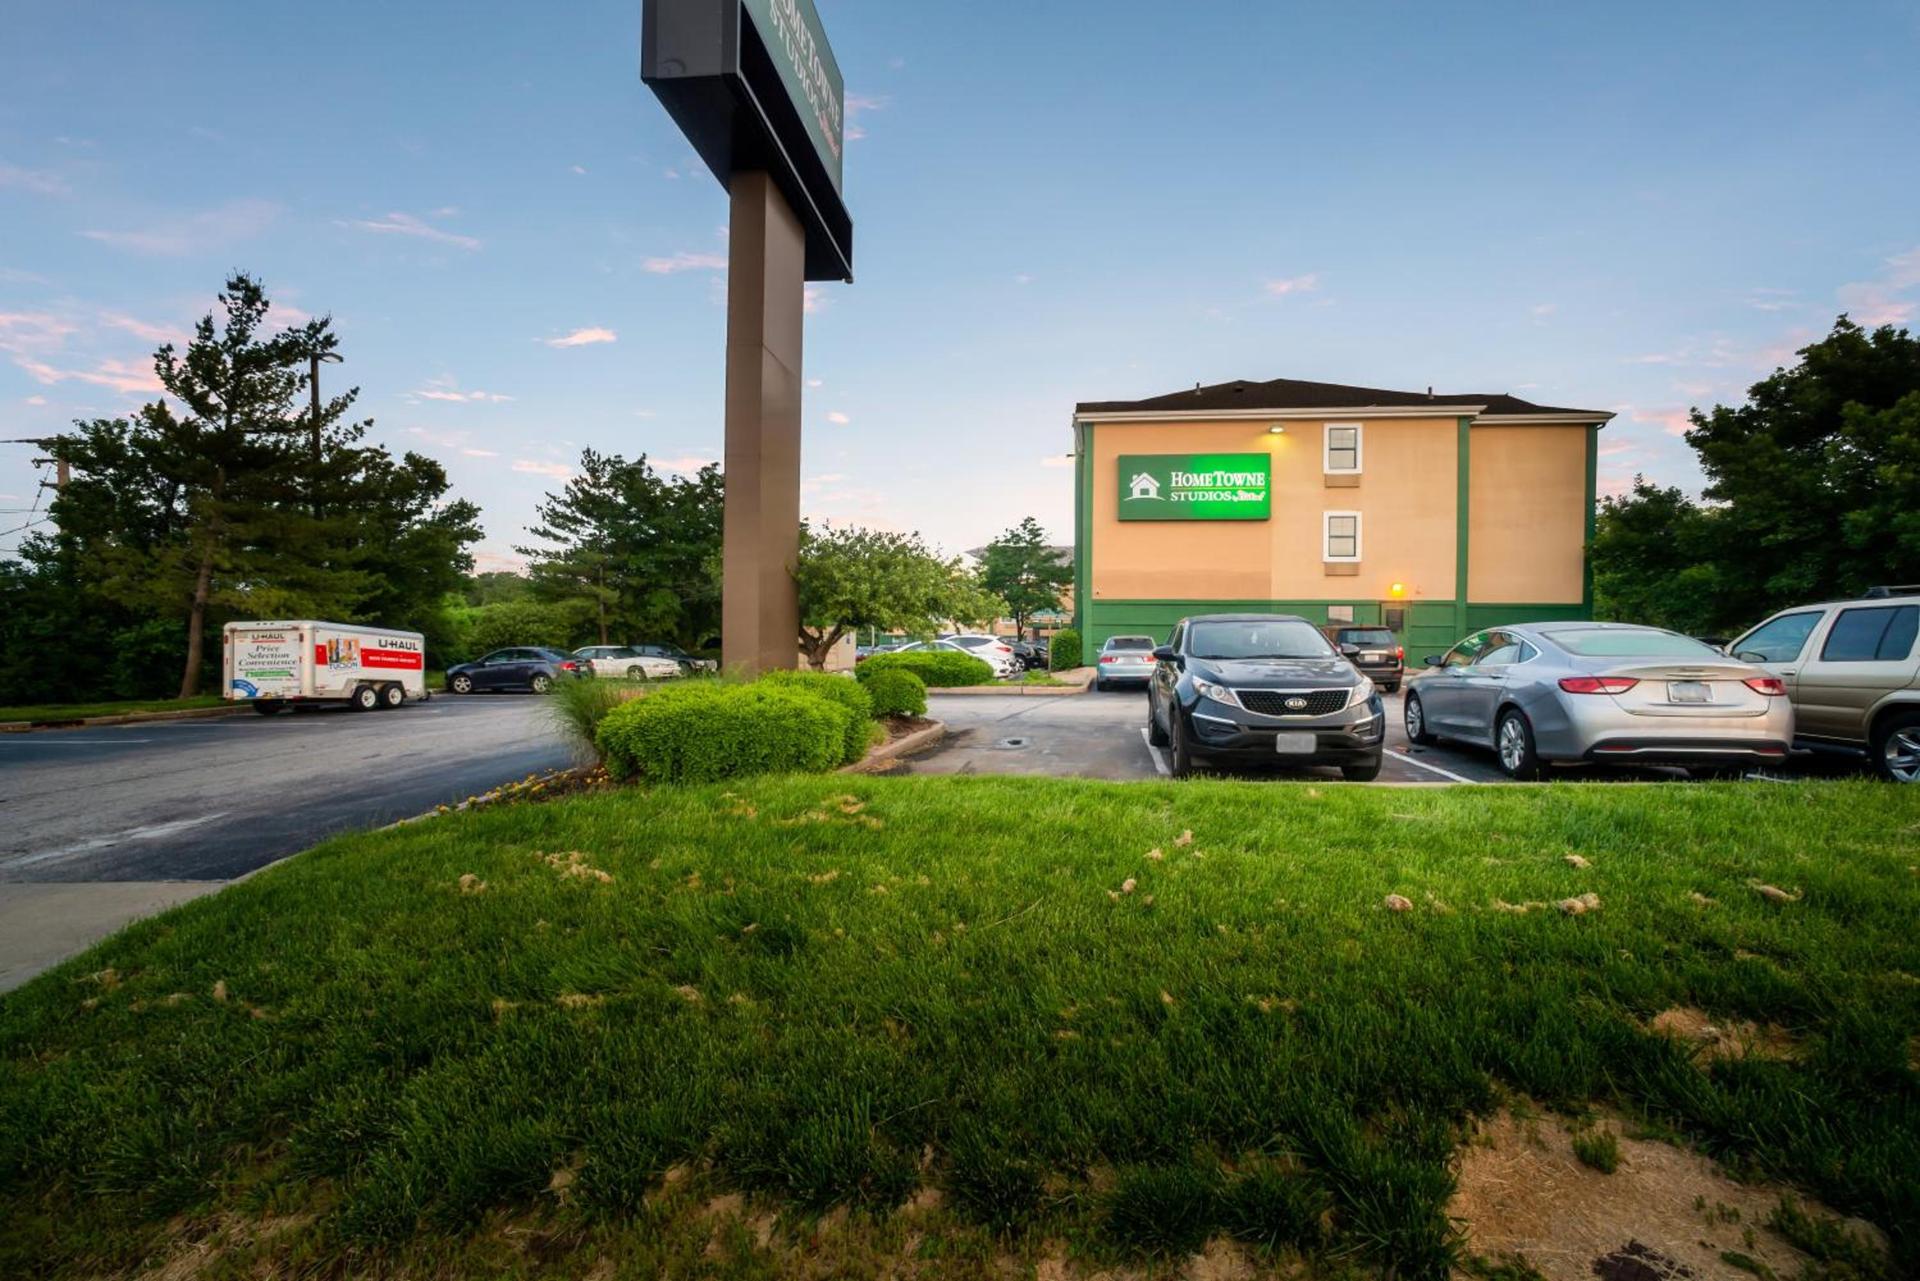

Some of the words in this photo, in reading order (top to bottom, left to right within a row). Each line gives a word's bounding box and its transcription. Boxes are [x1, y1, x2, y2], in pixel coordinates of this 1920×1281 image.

[1170, 471, 1265, 487] HOMETOWNE
[1170, 490, 1232, 502] STUDIOS
[378, 639, 418, 651] U-HAUL
[238, 659, 297, 667] Convenience
[1286, 699, 1306, 708] KIA
